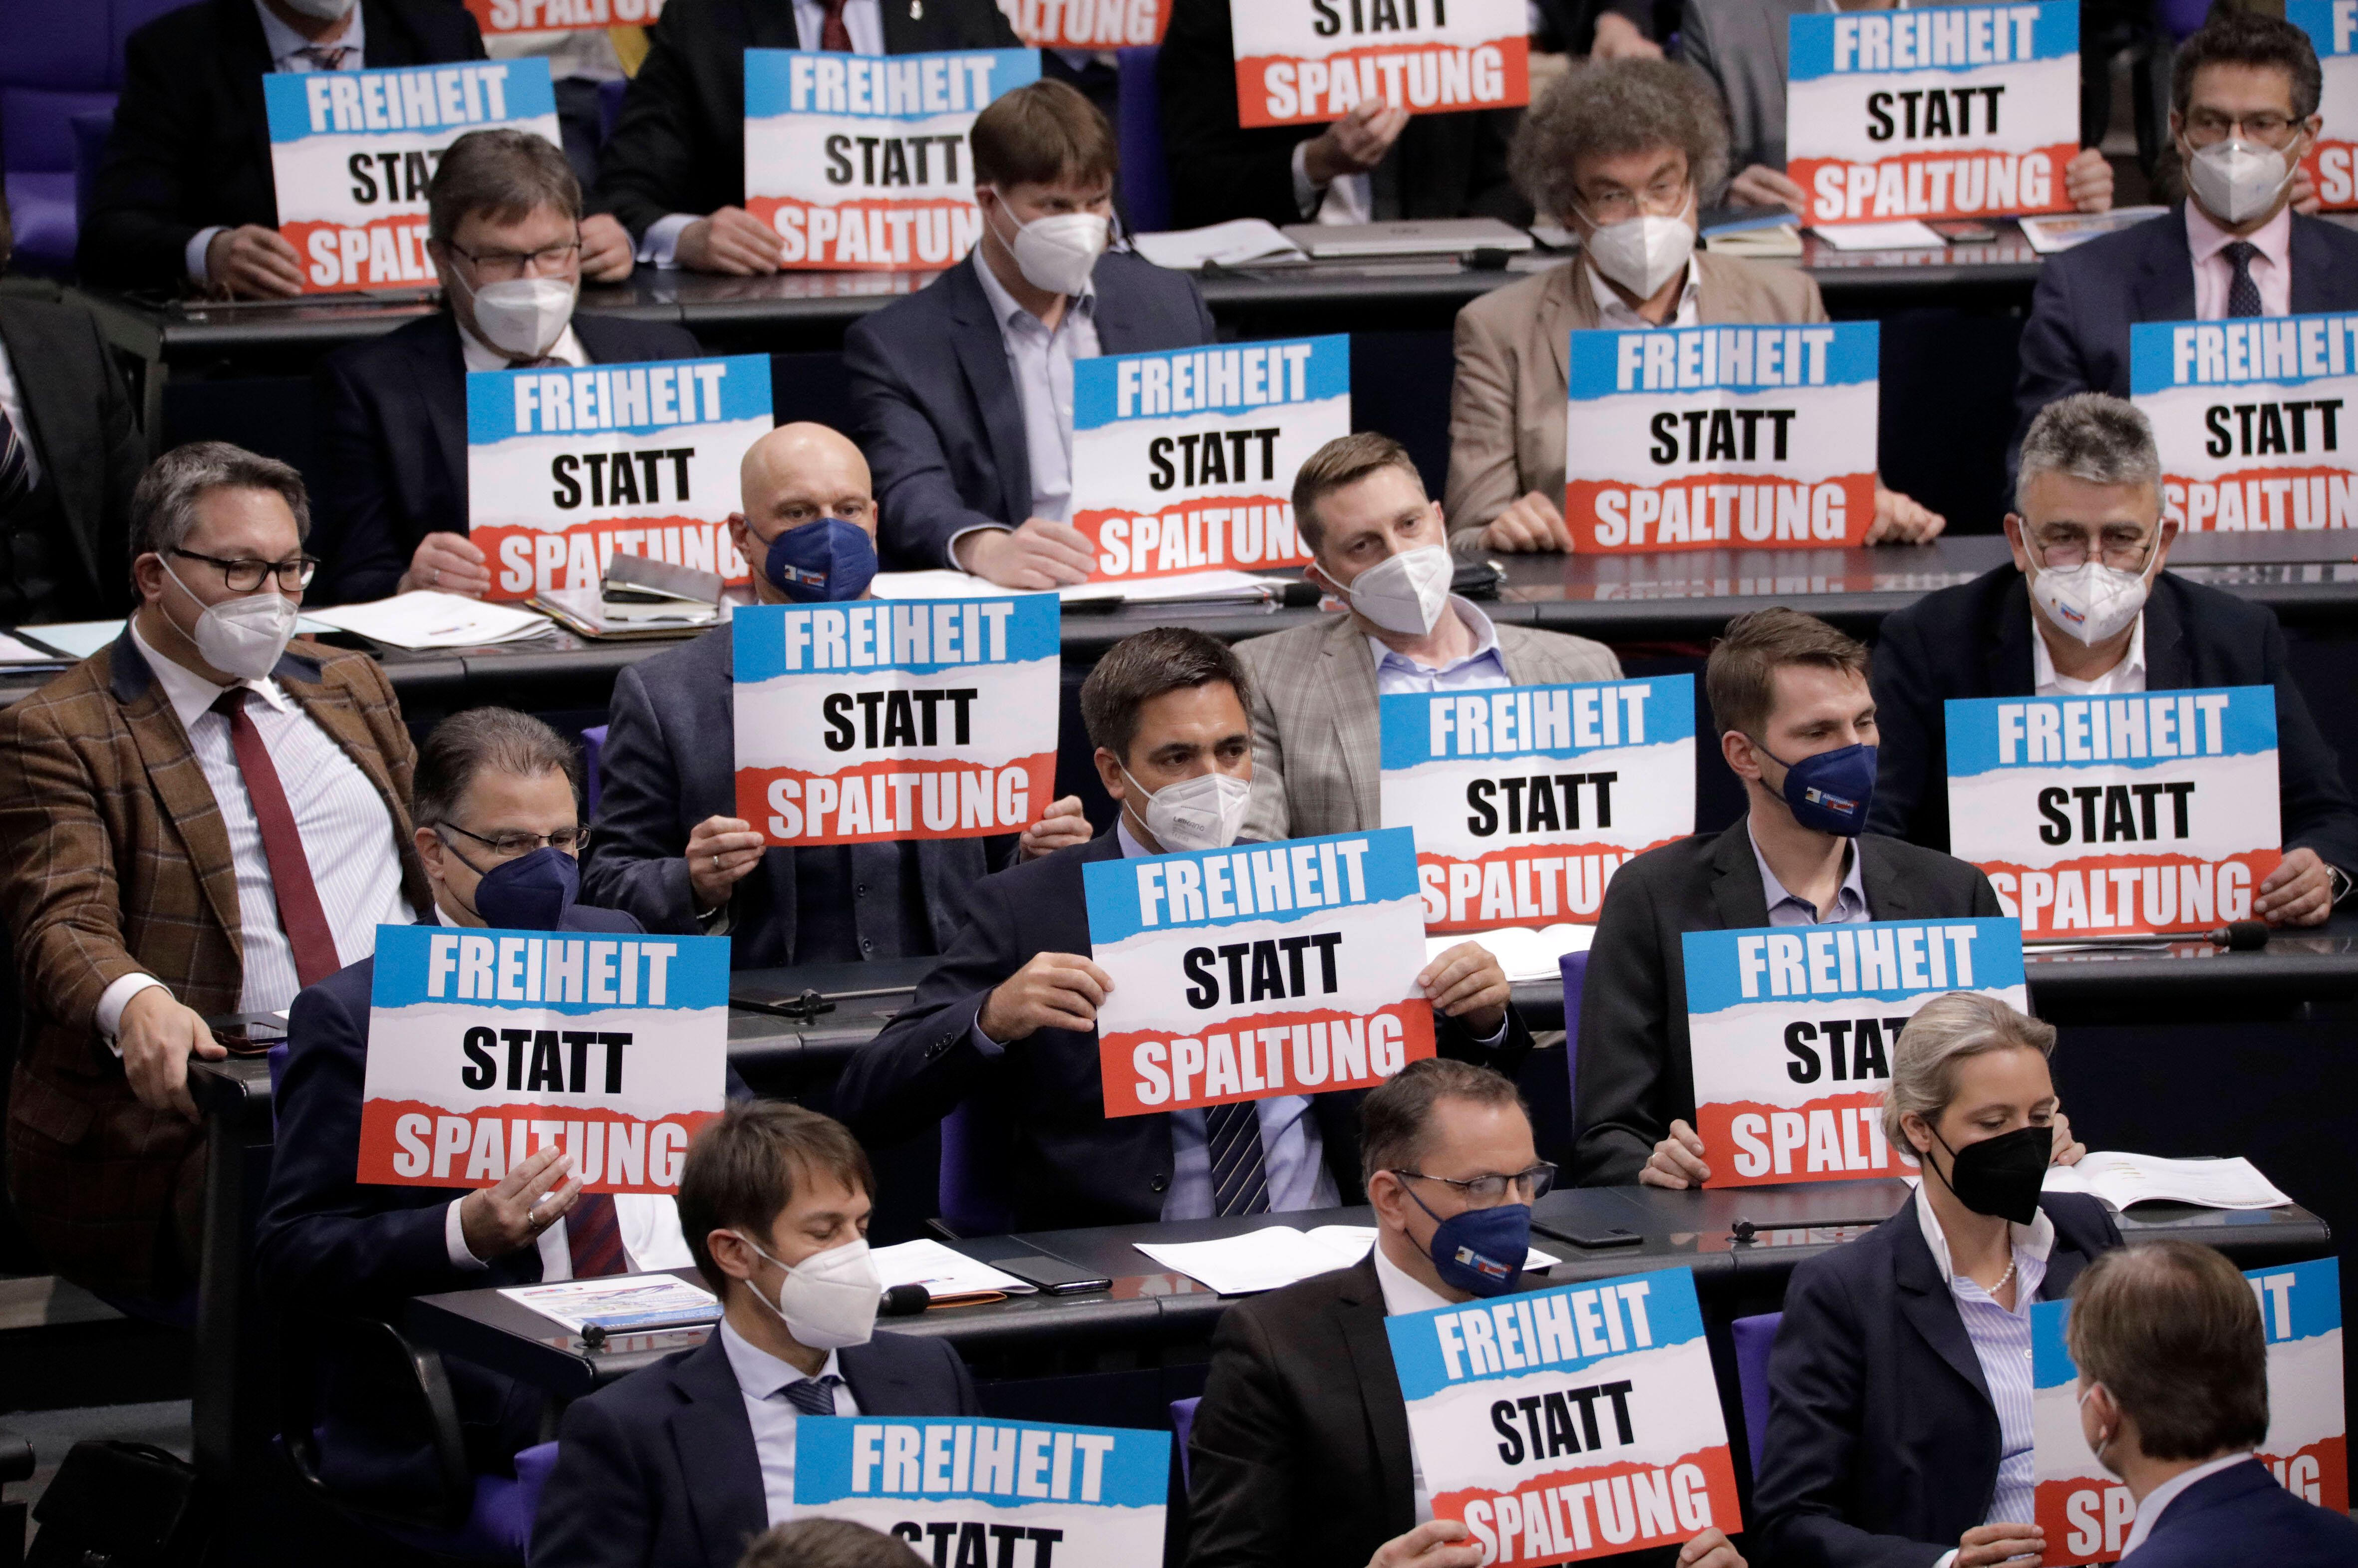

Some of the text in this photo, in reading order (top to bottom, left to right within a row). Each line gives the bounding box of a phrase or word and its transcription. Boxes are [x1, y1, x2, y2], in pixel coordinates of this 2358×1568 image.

[1833, 6, 2040, 71] FREIHEIT
[305, 65, 509, 132] FREIHEIT
[790, 55, 996, 116] FREIHEIT
[1264, 46, 1504, 119] SPALTUNG
[1866, 85, 2006, 141] STATT
[825, 133, 964, 187] STATT
[1813, 153, 2051, 220] SPALTUNG
[774, 206, 983, 263] SPALTUN
[1118, 344, 1312, 417] FREIHEIT
[1617, 328, 1834, 391] FREIHEIT
[514, 363, 726, 433] FREIHEIT
[2205, 399, 2344, 458] STATT
[1149, 428, 1281, 491] STATT
[1649, 408, 1796, 465] STATT
[552, 448, 695, 510] STATT
[2164, 473, 2358, 532] SPALTUN
[1594, 483, 1846, 546] SPALTUNG
[785, 602, 1014, 670] FREIHEIT
[823, 688, 978, 752] STATT
[1430, 684, 1651, 757] FREIHEIT
[1997, 694, 2229, 765] FREIHEIT
[767, 766, 1029, 839] SPALTUNG
[1467, 771, 1618, 837] STATT
[2037, 782, 2195, 846] STATT
[1136, 838, 1369, 927] FREIHEIT
[427, 934, 677, 1006] FREIHEIT
[1183, 931, 1342, 1011] STATT
[1737, 925, 1977, 999] FREIHEIT
[462, 1027, 633, 1094] STATT
[1133, 1014, 1406, 1106] SPALTUNG
[1434, 1281, 1652, 1380] FREIHEIT
[1489, 1379, 1635, 1466] STATT
[852, 1425, 1115, 1503] FREIHEIT
[1464, 1463, 1713, 1567] SPALTUNG
